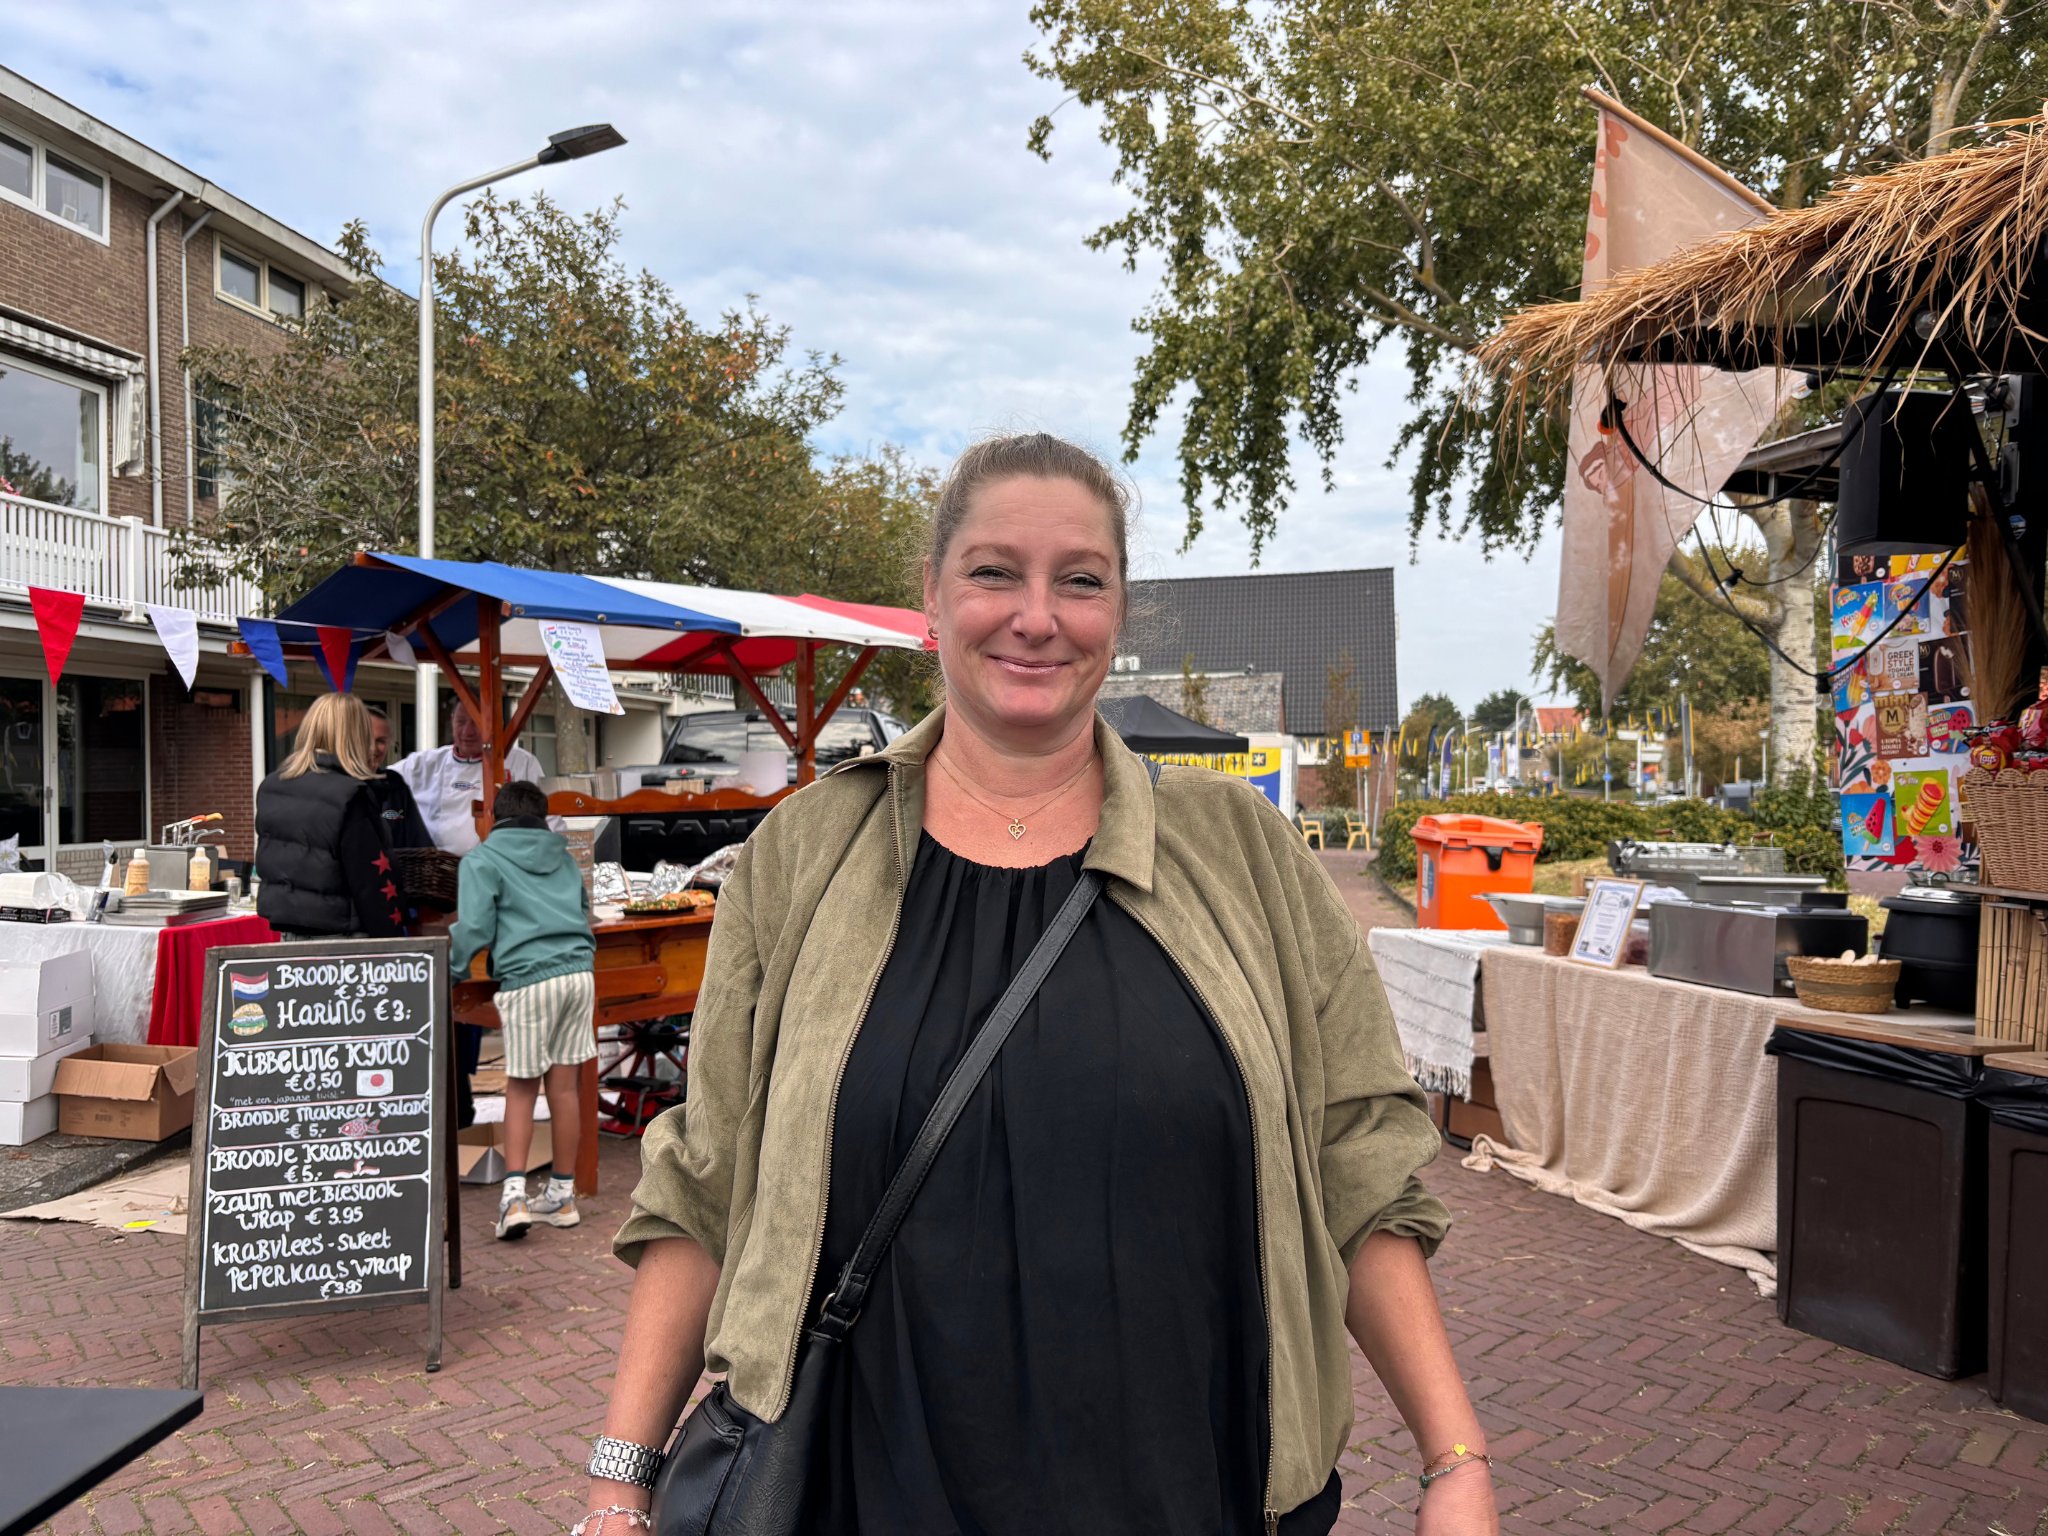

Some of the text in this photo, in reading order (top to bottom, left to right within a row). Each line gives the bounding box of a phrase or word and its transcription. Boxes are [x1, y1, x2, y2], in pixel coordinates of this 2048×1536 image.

[1887, 650, 1914, 660] GREEK
[1887, 658, 1914, 667] STYLE
[1887, 666, 1914, 674] YOGHURT
[1886, 709, 1899, 723] M
[628, 818, 748, 837] RAM
[334, 984, 351, 1000] €
[255, 1096, 271, 1105] een
[273, 1093, 311, 1105] japanse
[285, 1123, 301, 1140] €
[279, 1186, 321, 1208] met
[304, 1206, 324, 1226] €
[328, 1205, 364, 1226] 3.95
